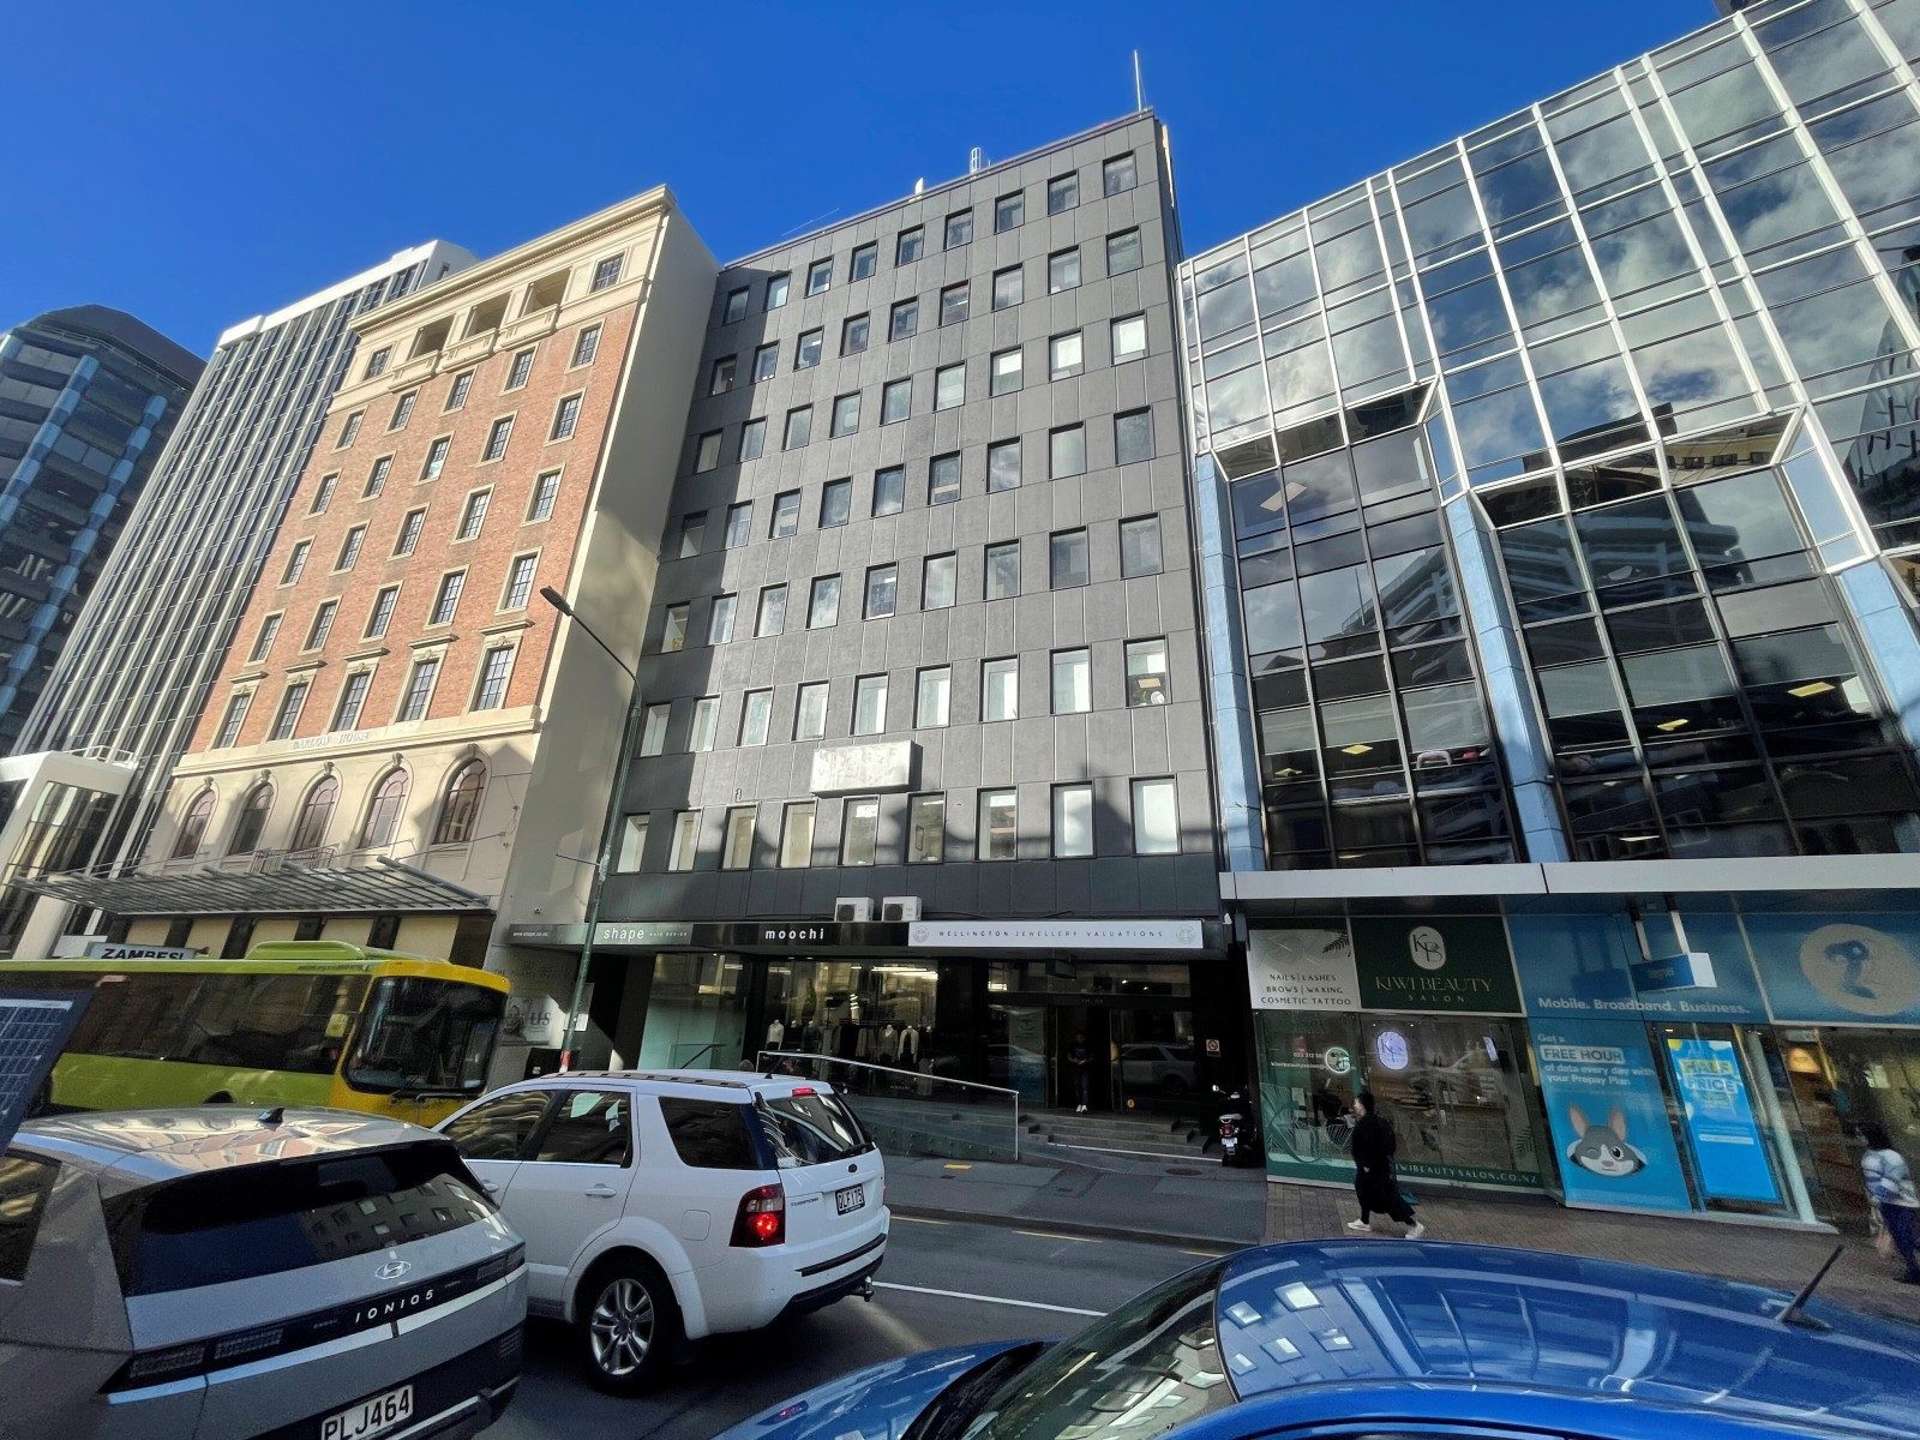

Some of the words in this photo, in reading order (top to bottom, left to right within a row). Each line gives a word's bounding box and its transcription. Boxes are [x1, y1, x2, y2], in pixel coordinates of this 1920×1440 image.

[603, 927, 645, 943] shape
[765, 928, 825, 940] moochi
[101, 947, 185, 960] ZAMBESI
[1269, 973, 1296, 981] NAILS
[1301, 973, 1337, 982] LASHES
[1375, 976, 1416, 990] KIWI
[1420, 976, 1492, 992] BEAUTY
[1306, 986, 1344, 994] WAXING
[1260, 996, 1307, 1004] COSMETIC
[1312, 998, 1352, 1006] TATTOO
[1408, 994, 1465, 1003] SALON
[1538, 997, 1590, 1009] Mobile.
[1594, 998, 1676, 1012] Broadband.
[1680, 1000, 1750, 1014] Business.
[1543, 1048, 1577, 1059] FREE
[1581, 1049, 1622, 1062] HOUR
[1557, 1064, 1579, 1073] data
[1395, 1162, 1538, 1185] IWIBEAUTYSALON.CO.NZ
[323, 1390, 411, 1440] PLJ464
